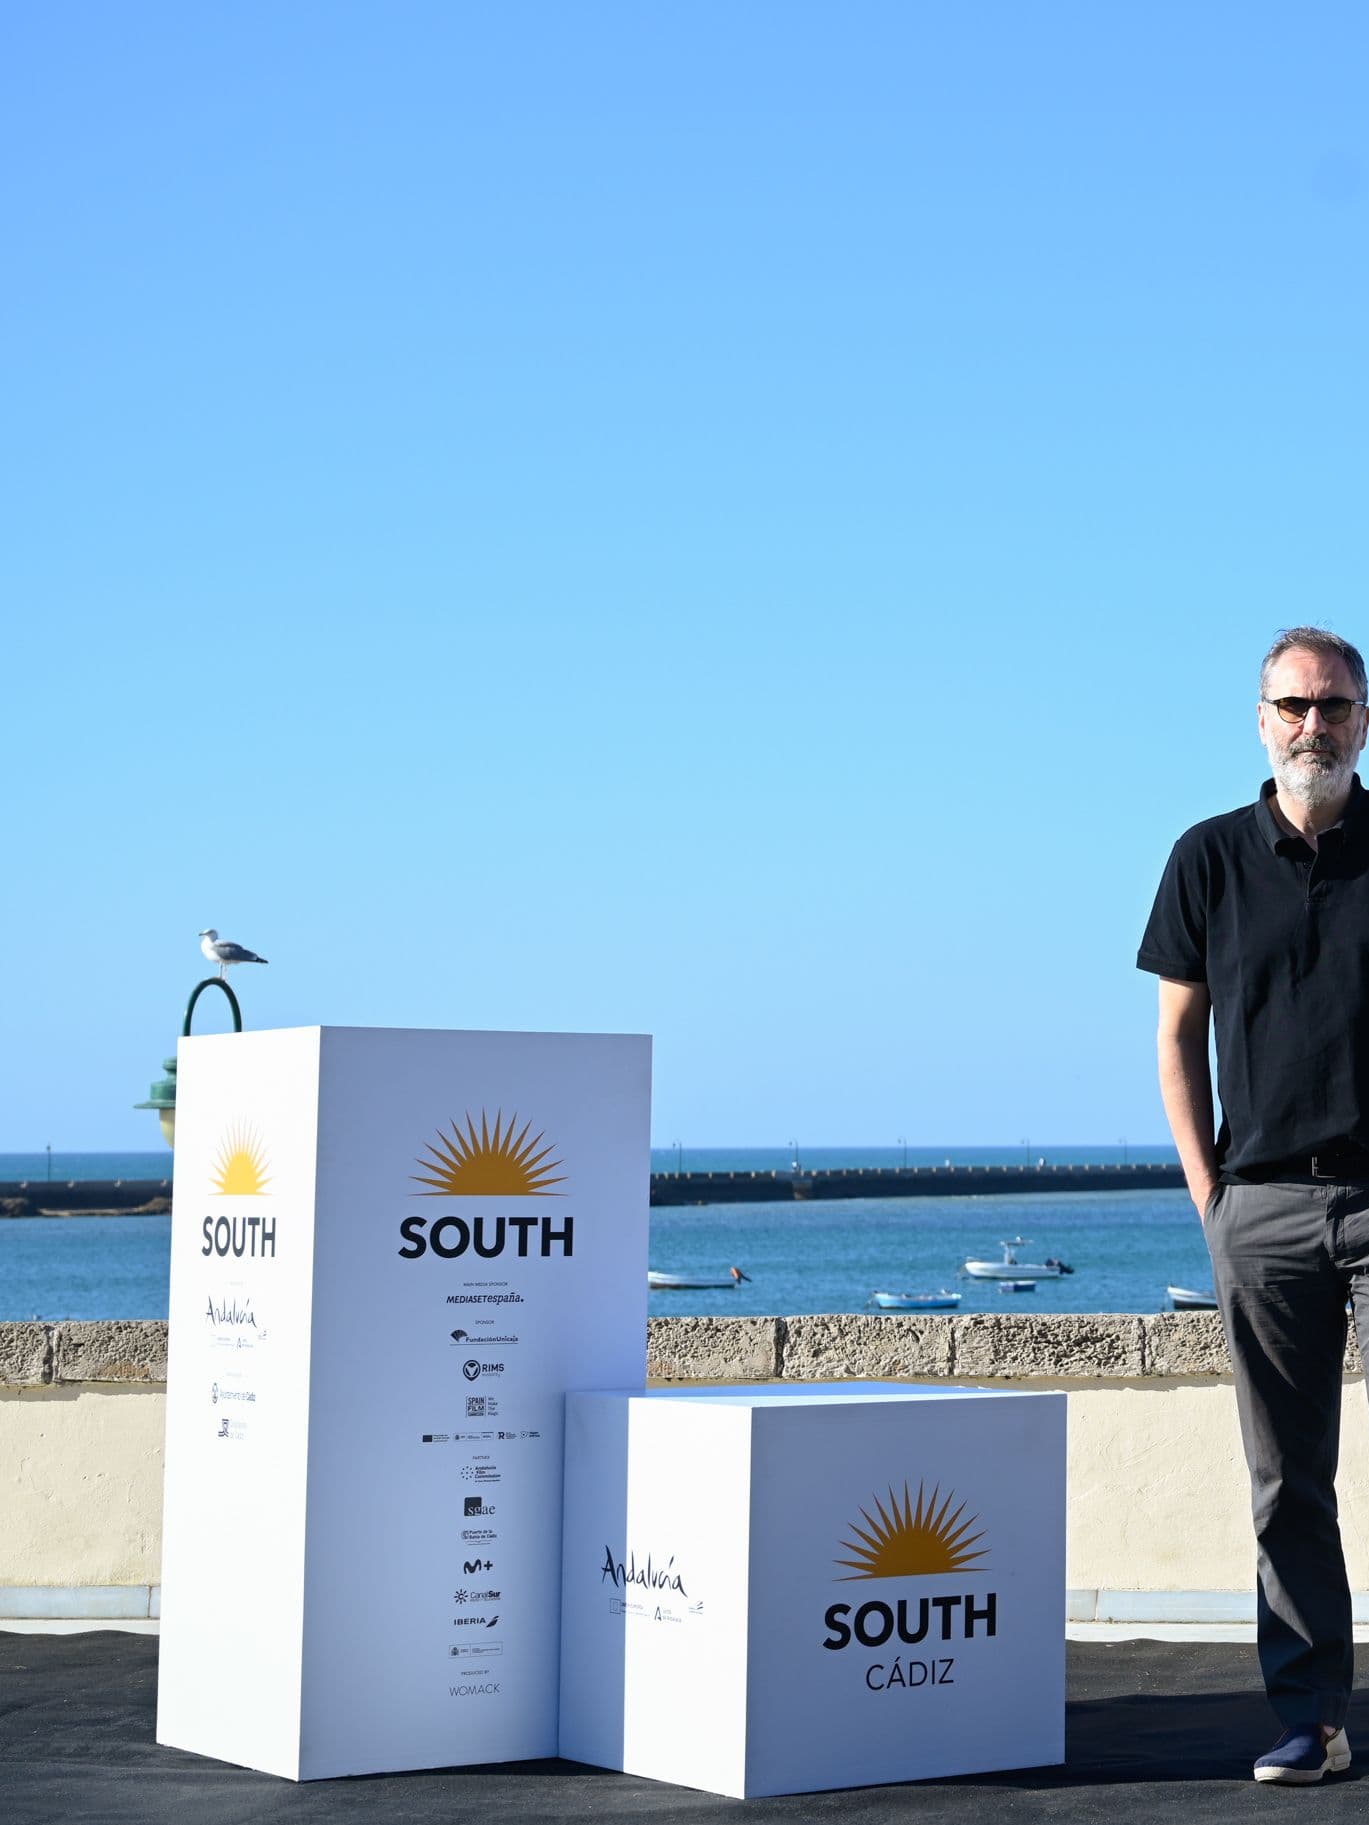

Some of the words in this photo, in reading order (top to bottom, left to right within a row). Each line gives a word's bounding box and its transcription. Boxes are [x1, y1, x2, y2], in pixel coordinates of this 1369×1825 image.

[202, 1215, 276, 1258] SOUTH
[398, 1216, 574, 1259] SOUTH
[206, 1296, 258, 1329] Andalucía
[482, 1363, 504, 1372] RIMS
[468, 1397, 484, 1405] SPAIN
[468, 1505, 496, 1517] sgae
[601, 1545, 688, 1598] Andalucía
[454, 1617, 487, 1626] IBERIA
[822, 1592, 997, 1651] SOUTH
[865, 1656, 955, 1690] CÁDIZ
[449, 1683, 501, 1697] WOMACK
